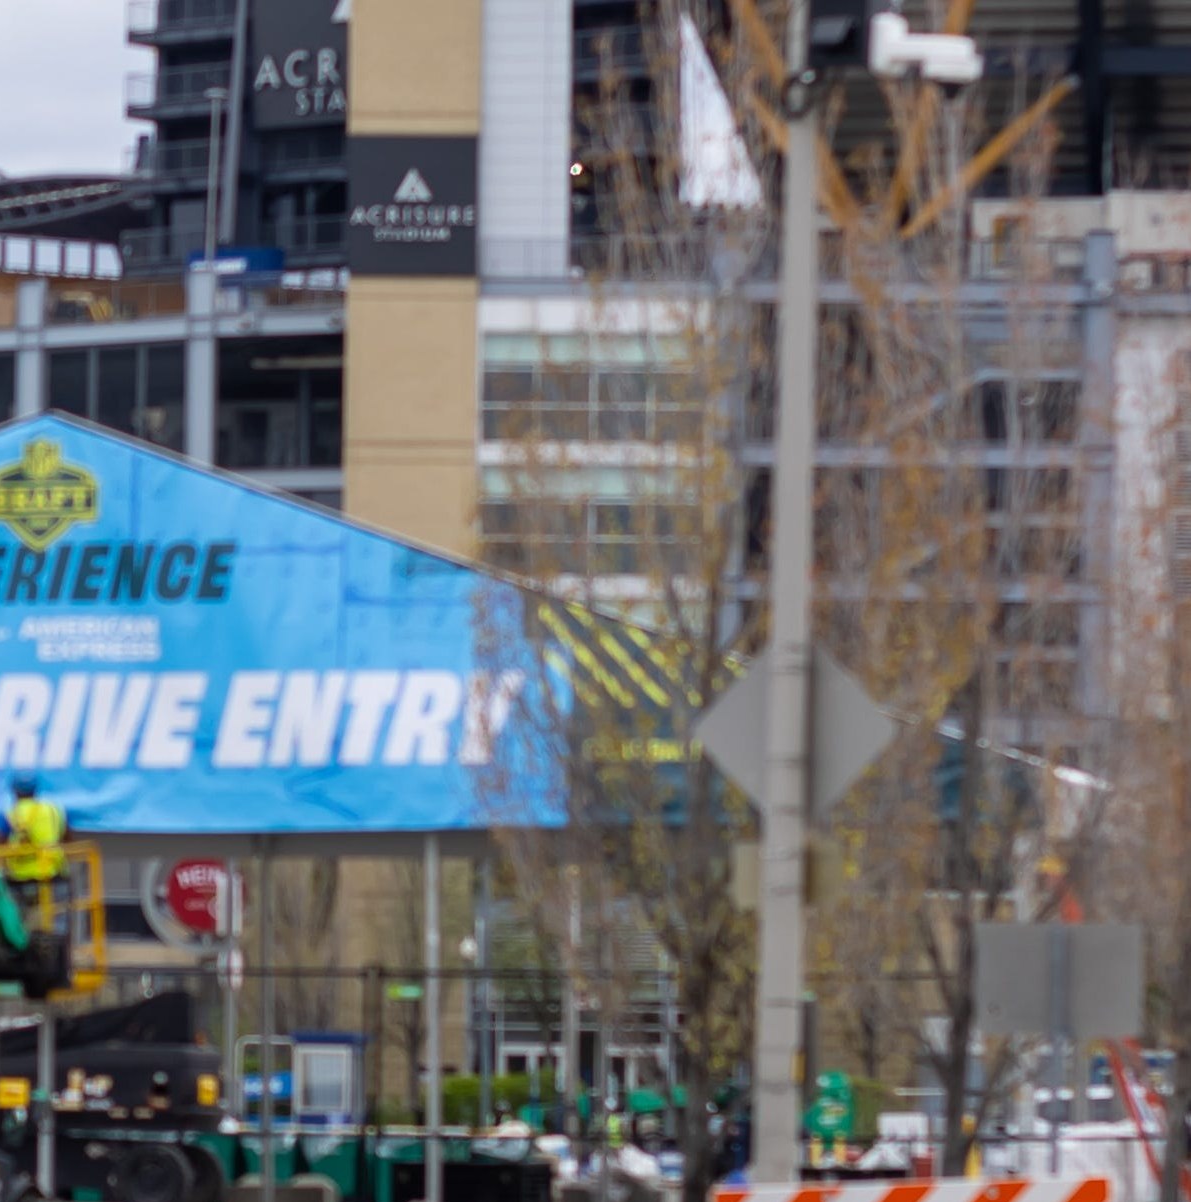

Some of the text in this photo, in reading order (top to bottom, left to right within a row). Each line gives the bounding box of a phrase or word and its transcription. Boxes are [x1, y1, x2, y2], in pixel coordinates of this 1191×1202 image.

[350, 204, 474, 226] ACRISURE
[19, 616, 158, 641] AMERICAN
[36, 640, 161, 663] EXPRESS
[211, 669, 525, 769] ENTRY
